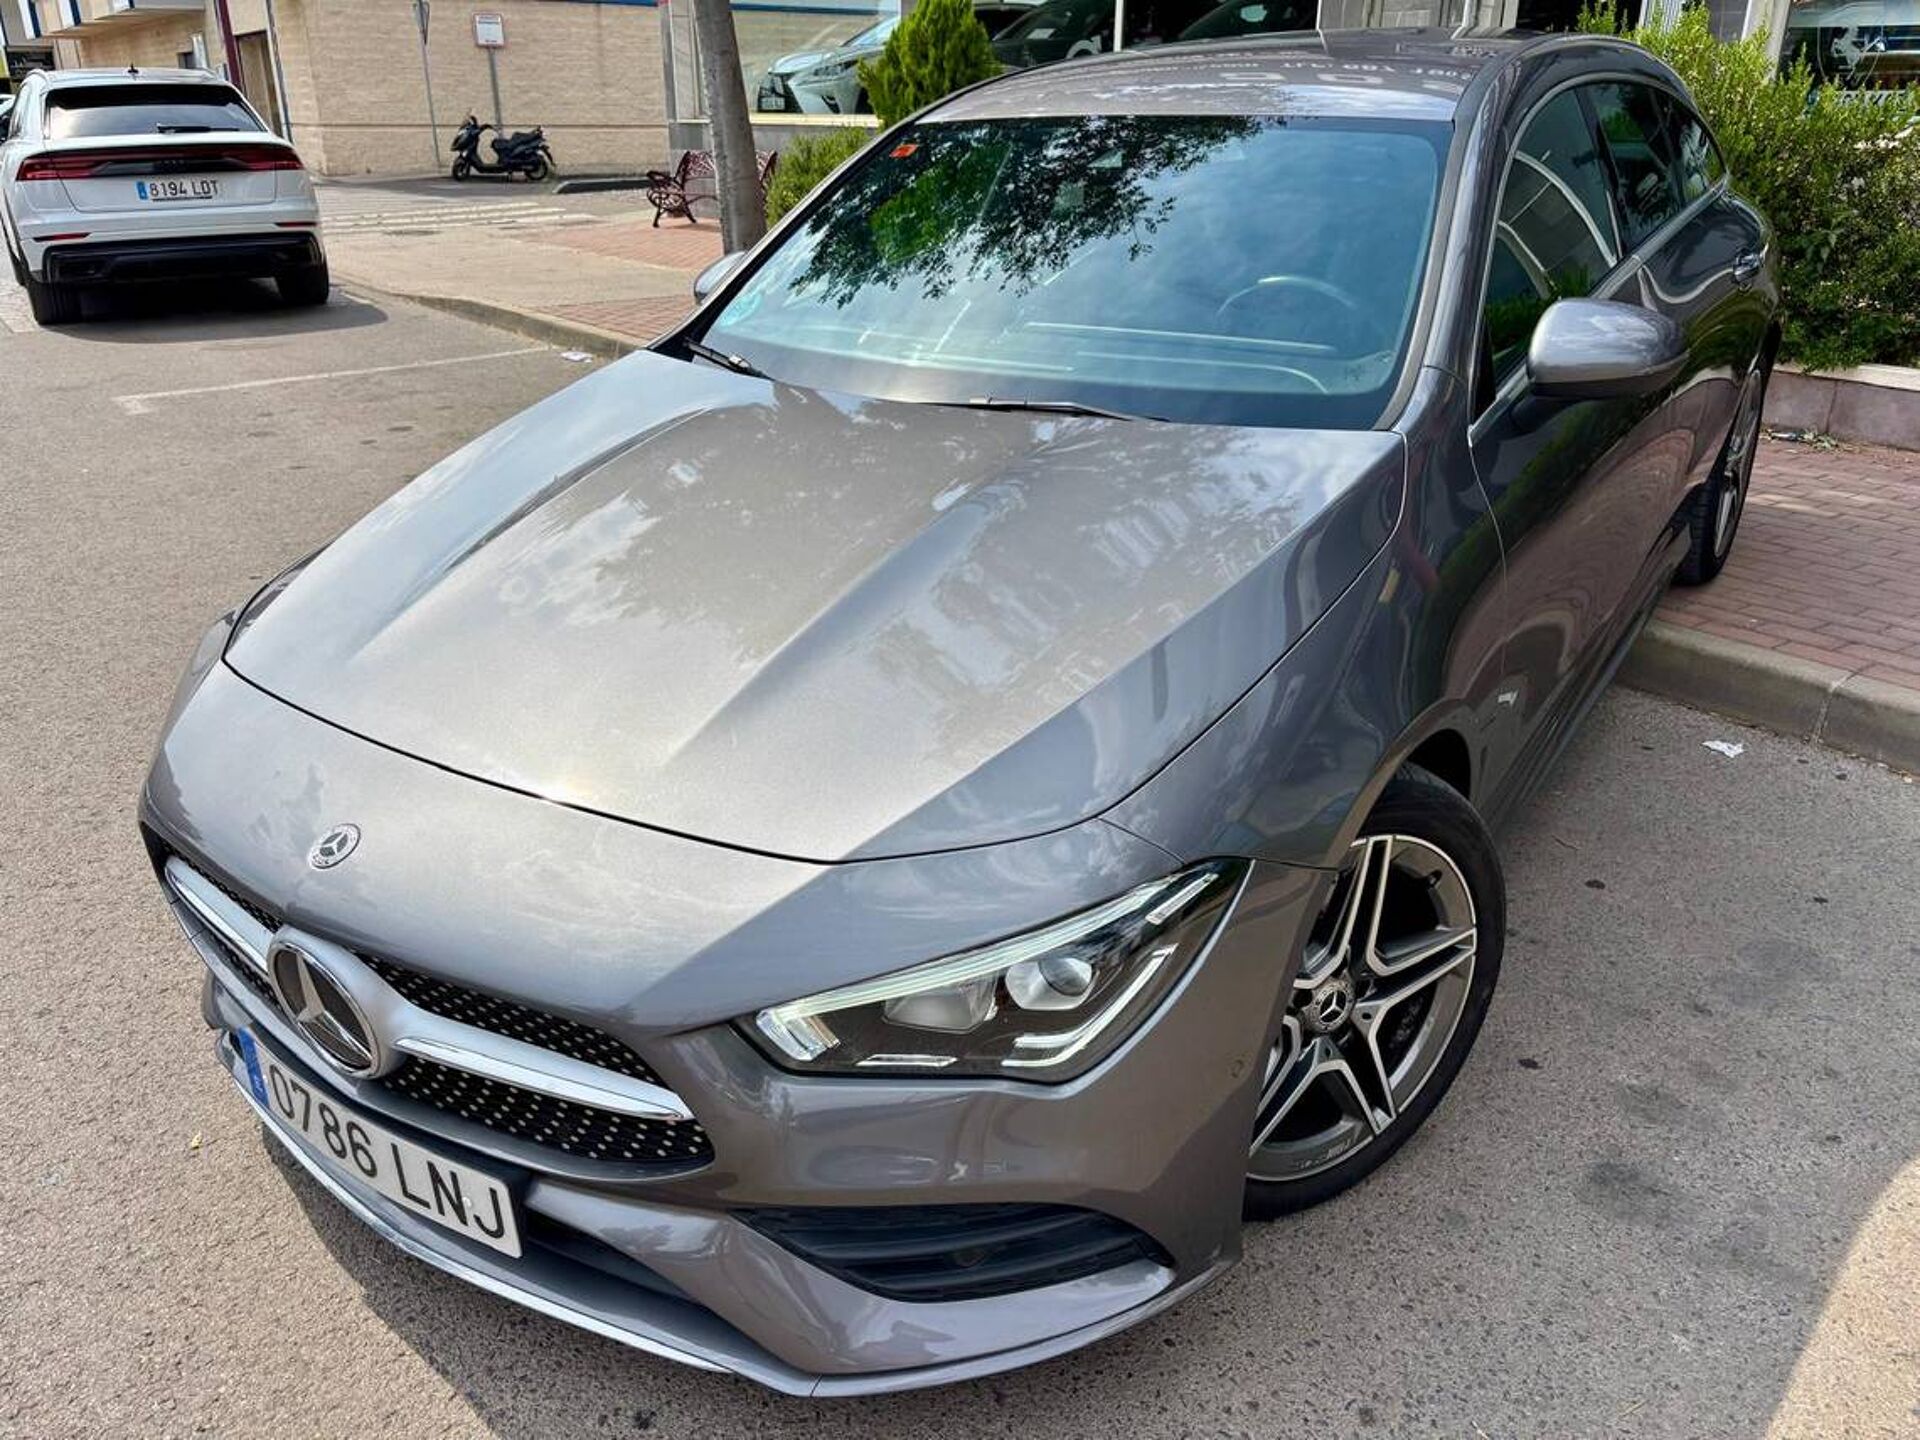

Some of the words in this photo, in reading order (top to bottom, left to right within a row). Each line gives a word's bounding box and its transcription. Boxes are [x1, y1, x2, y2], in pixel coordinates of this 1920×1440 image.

[149, 181, 188, 197] 8194
[269, 1064, 378, 1178] 0786
[390, 1142, 505, 1239] LNJ
